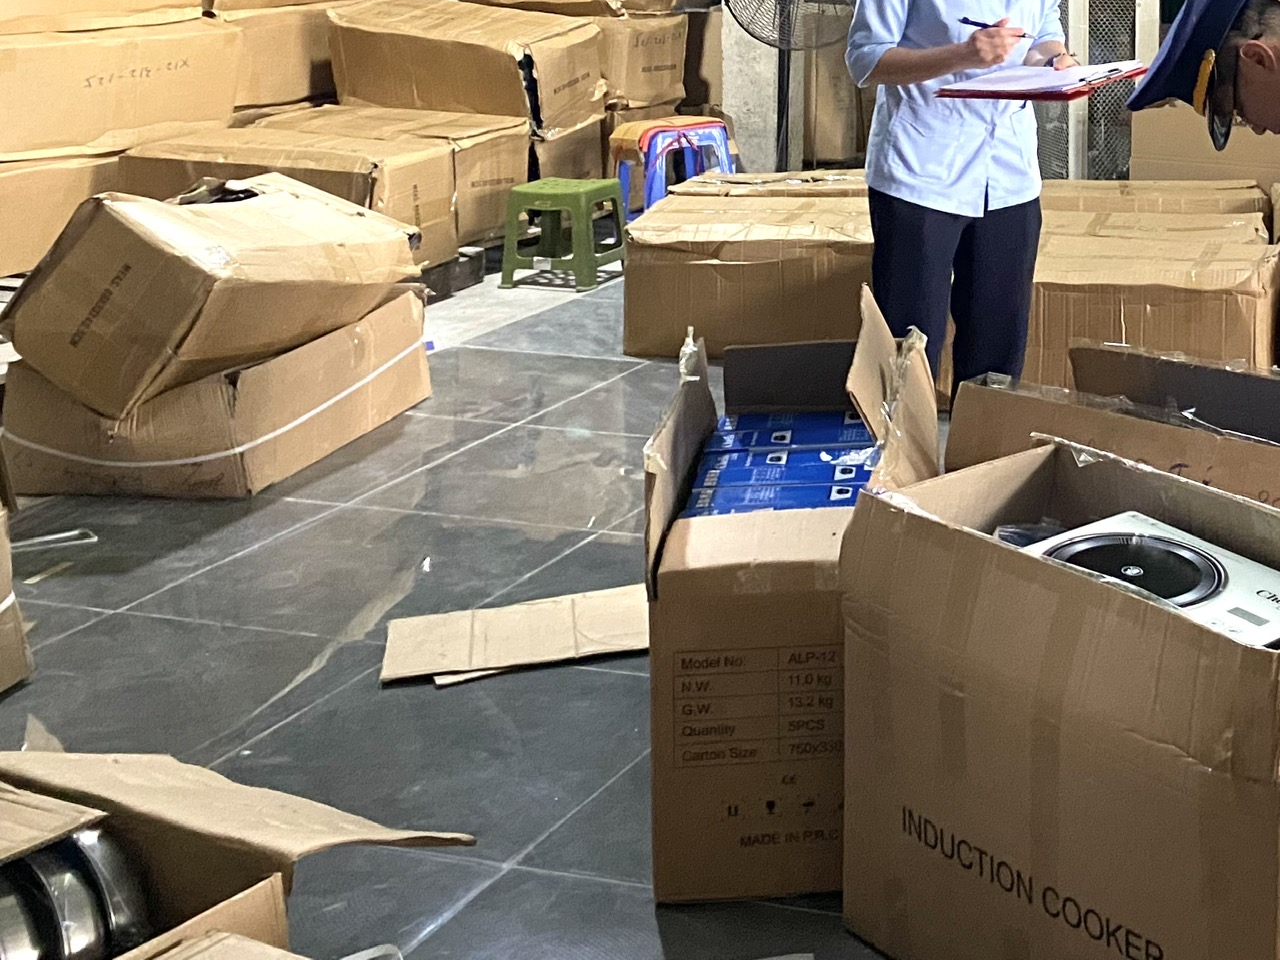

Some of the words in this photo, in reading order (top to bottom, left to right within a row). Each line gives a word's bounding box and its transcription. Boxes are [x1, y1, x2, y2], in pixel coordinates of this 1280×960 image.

[681, 656, 721, 669] Model
[788, 651, 836, 664] ALP-12
[816, 673, 833, 686] kg
[818, 696, 834, 709] kg
[682, 724, 736, 737] Quantity
[729, 747, 758, 759] Size
[740, 833, 781, 847] MADE
[785, 831, 800, 843] IN
[901, 805, 1034, 905] INDUCTION
[1041, 886, 1164, 960] COOKER
